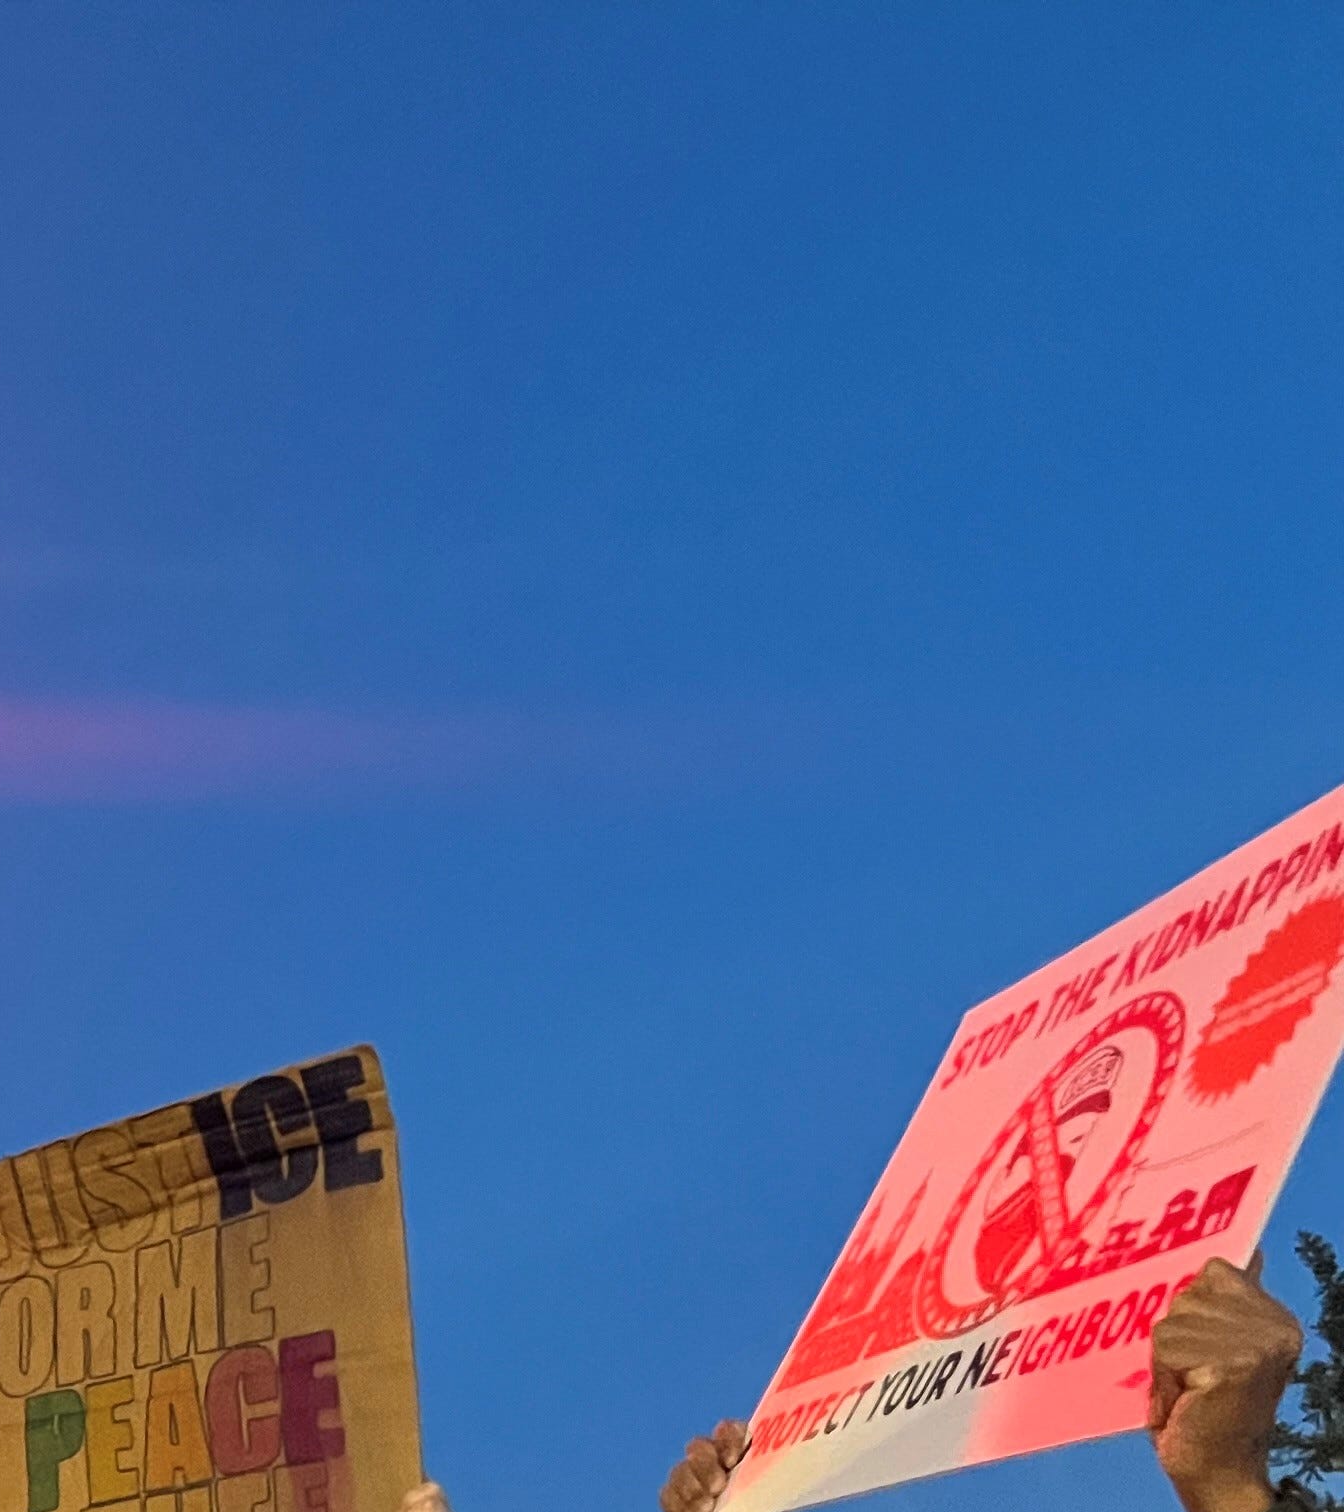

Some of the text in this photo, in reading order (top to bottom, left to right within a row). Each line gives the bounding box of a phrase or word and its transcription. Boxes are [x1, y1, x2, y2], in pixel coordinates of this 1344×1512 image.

[940, 1000, 1040, 1091] STOP
[1034, 953, 1120, 1040] THE
[133, 1211, 277, 1370] ME
[752, 1381, 875, 1460] PROTECT
[867, 1351, 962, 1422] YOUR
